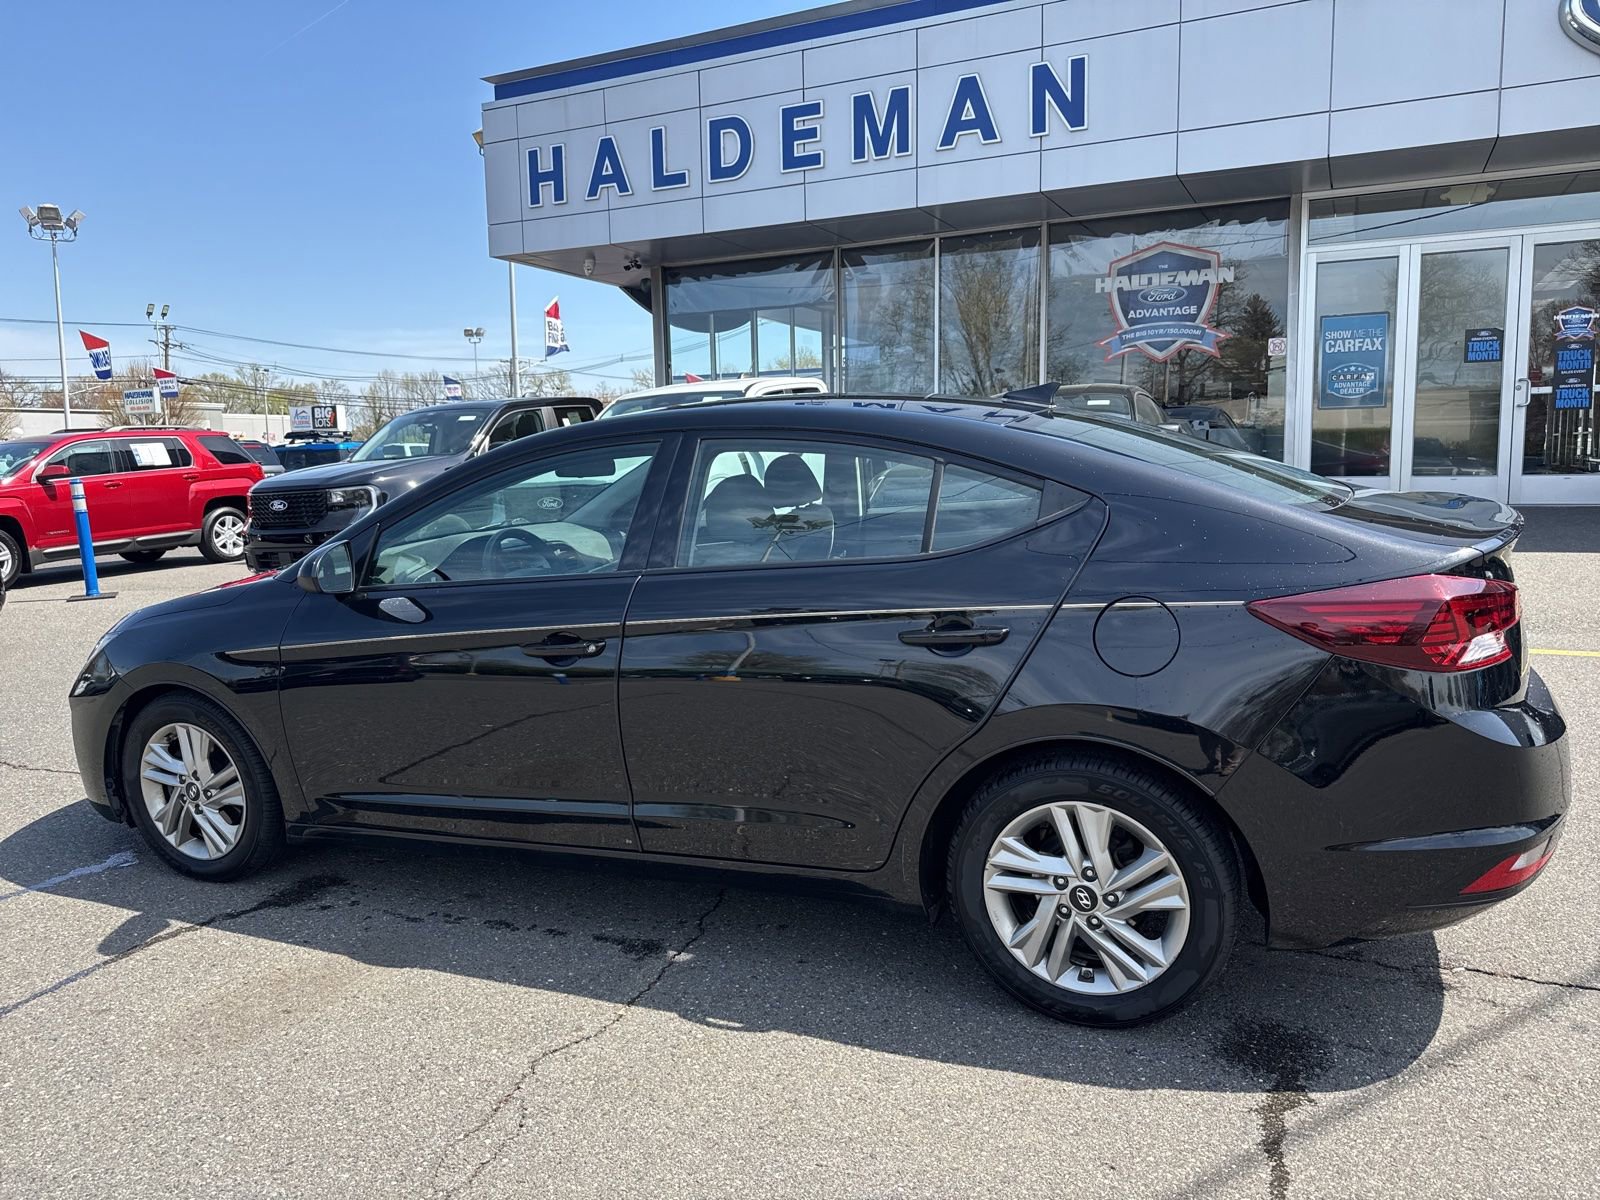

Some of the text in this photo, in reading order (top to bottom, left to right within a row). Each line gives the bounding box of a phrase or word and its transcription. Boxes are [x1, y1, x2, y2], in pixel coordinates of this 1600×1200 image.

[526, 54, 1088, 208] HALDEMAN
[1095, 266, 1235, 293] HALDEMAN
[1147, 287, 1177, 301] Ford
[1127, 305, 1198, 319] ADVANTAGE
[1324, 328, 1384, 340] SHOW ME THE
[1325, 338, 1383, 353] CARFAX
[1468, 341, 1500, 351] TRUCK
[1468, 351, 1500, 360] MONTH
[1558, 349, 1592, 360] TRUCK
[1558, 360, 1592, 370] MONTH
[1331, 372, 1375, 381] CARFAX
[1333, 381, 1371, 389] ADVANTAGE
[1556, 388, 1590, 399] TRUCK
[126, 398, 153, 406] COLLISION
[1556, 399, 1590, 408] MONTH
[313, 407, 333, 418] BIG
